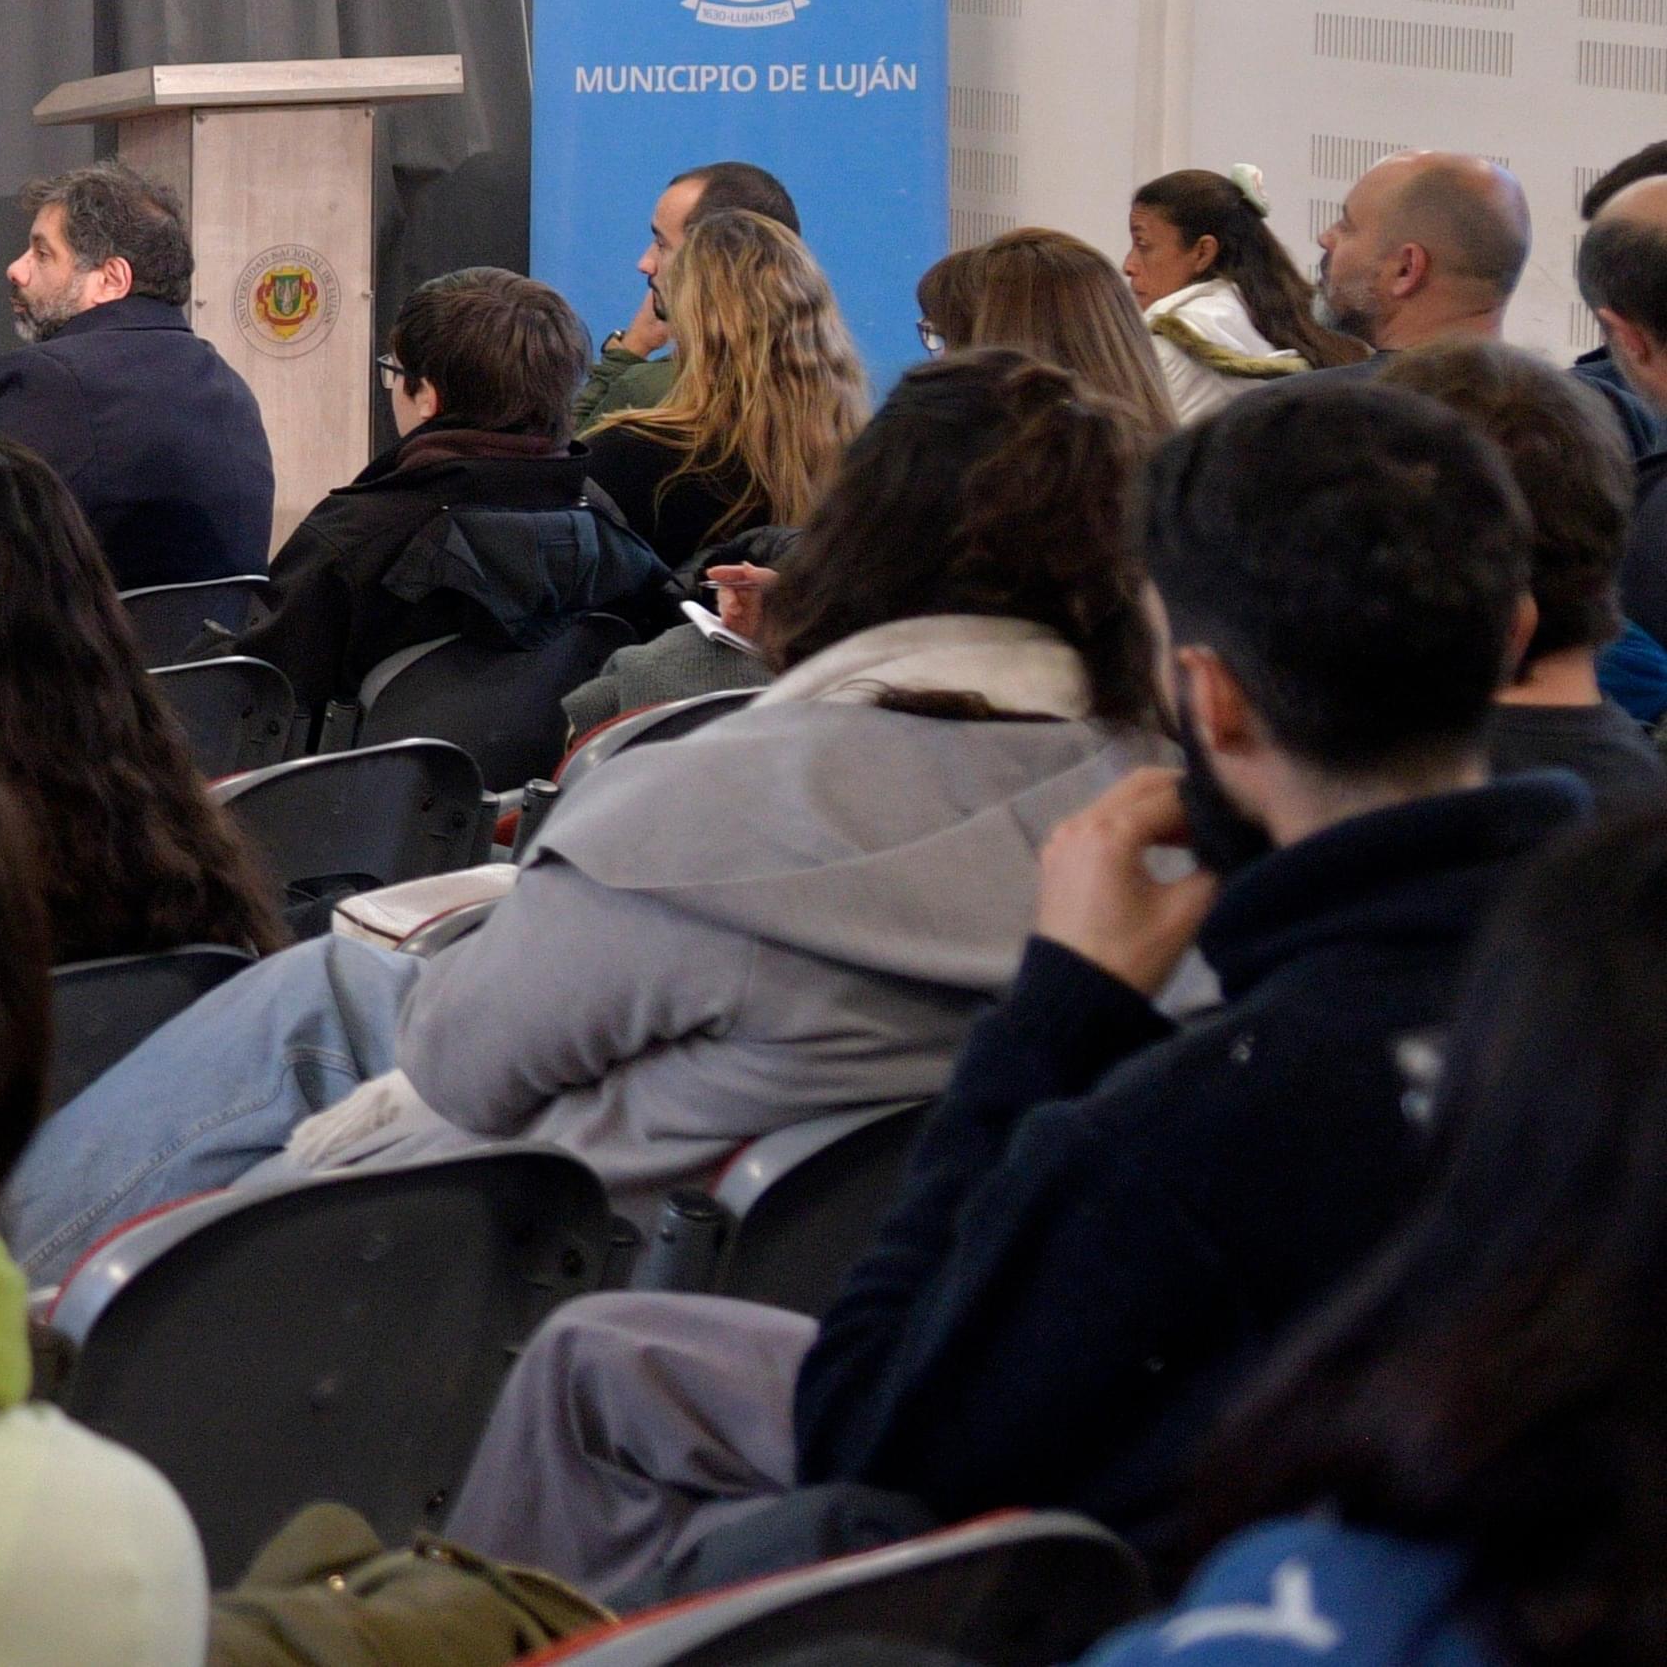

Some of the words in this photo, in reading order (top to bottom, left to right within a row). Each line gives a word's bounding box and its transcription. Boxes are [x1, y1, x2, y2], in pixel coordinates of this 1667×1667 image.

[575, 64, 758, 94] MUNICIPIO
[767, 64, 807, 93] DE
[817, 56, 918, 98] LUJÁN
